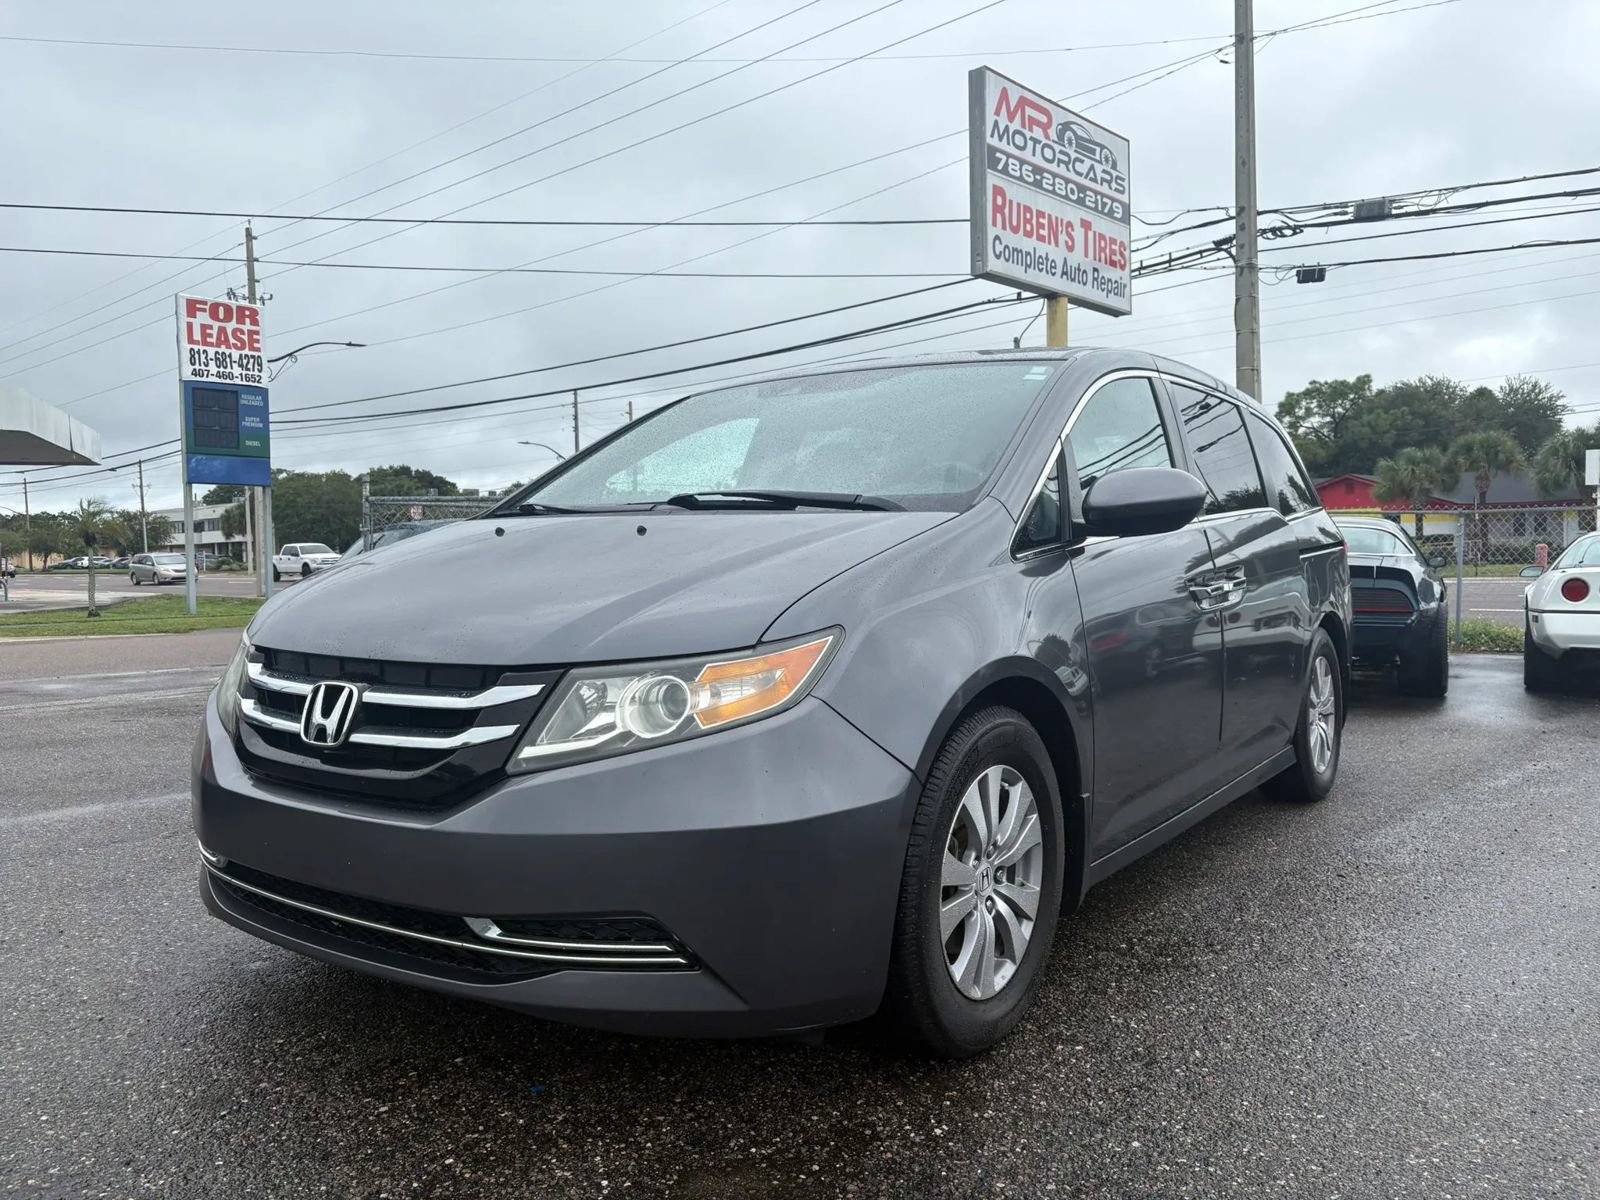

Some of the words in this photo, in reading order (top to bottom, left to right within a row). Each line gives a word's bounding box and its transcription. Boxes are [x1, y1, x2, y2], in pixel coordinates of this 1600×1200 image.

[994, 86, 1052, 140] MR
[990, 119, 1126, 195] MOTORCARS
[995, 152, 1123, 219] 786-280-2179
[991, 184, 1075, 253] RUBEN'S
[1080, 217, 1127, 272] TIRES
[992, 234, 1057, 277] Complete
[1060, 257, 1088, 286] Auto
[1091, 267, 1127, 299] Repair
[186, 299, 260, 326] FOR
[186, 321, 261, 352] LEASE
[189, 347, 263, 373] 813-681-4279
[191, 368, 262, 384] 407-460-1652
